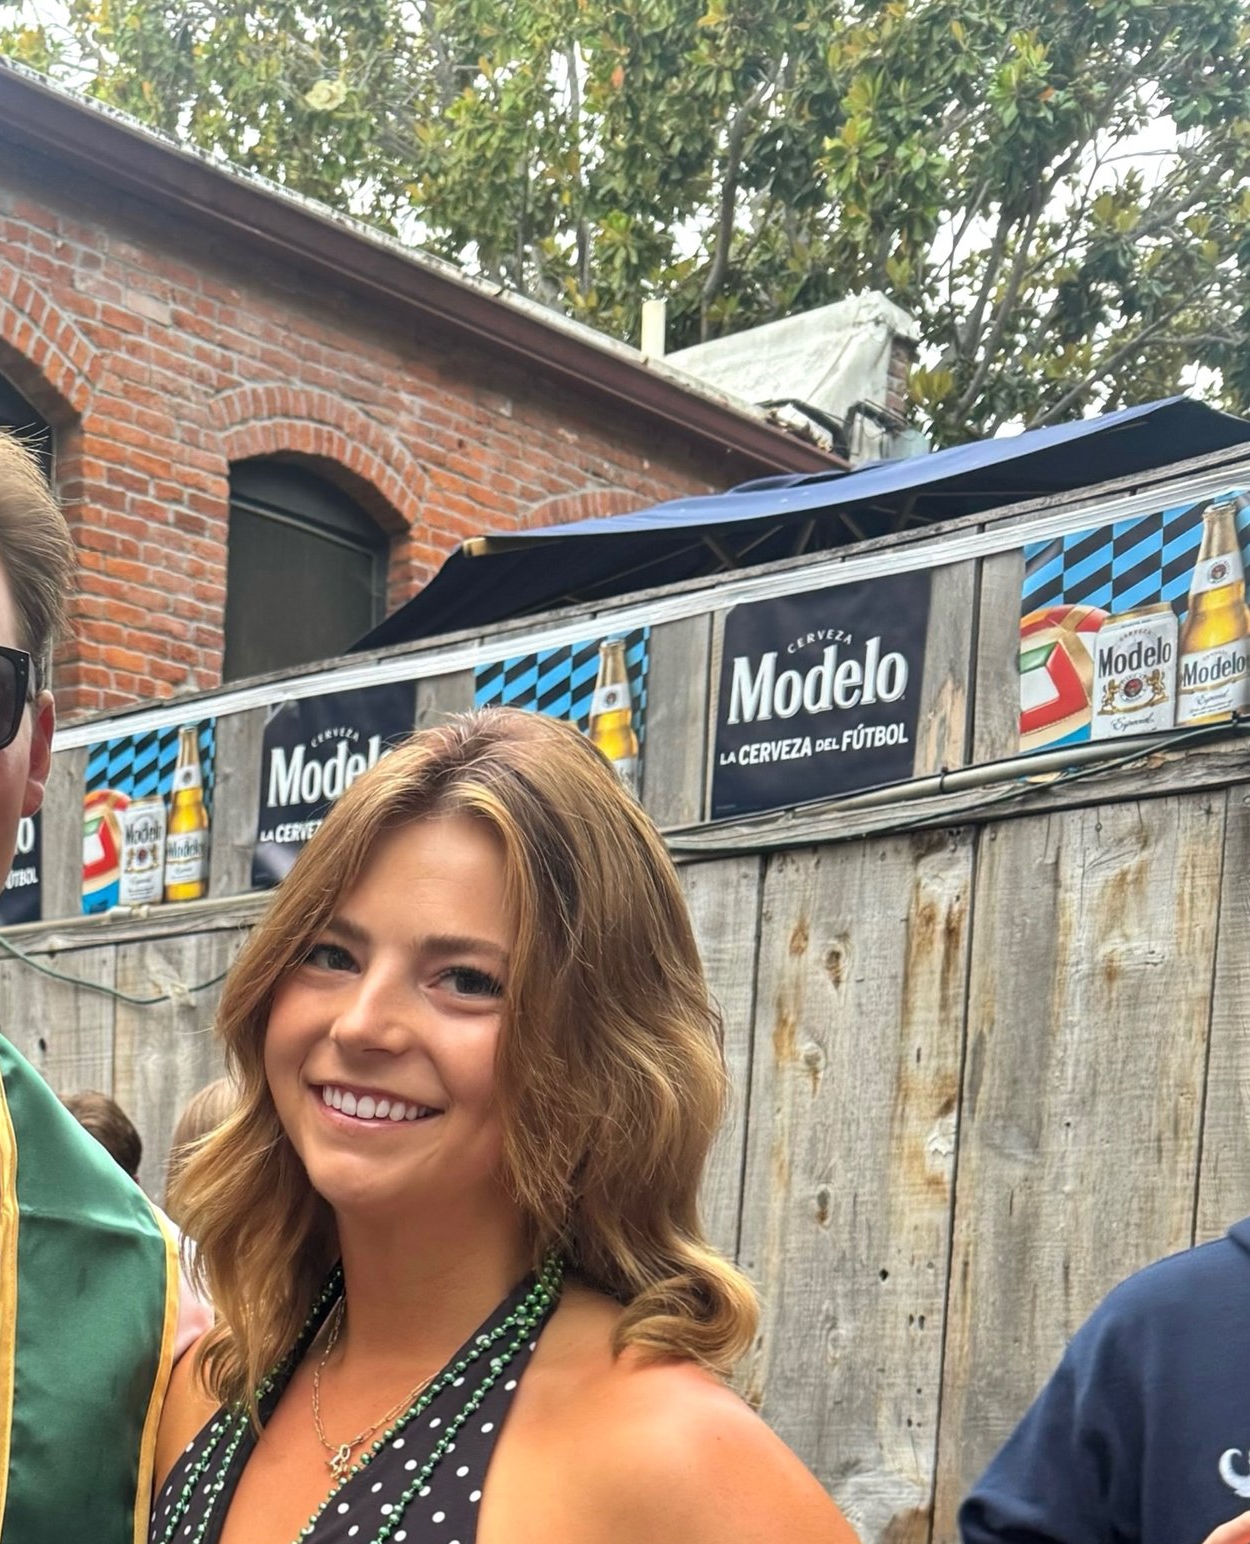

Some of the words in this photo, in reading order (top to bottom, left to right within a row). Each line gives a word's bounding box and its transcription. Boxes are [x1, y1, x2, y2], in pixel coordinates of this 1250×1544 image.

[787, 628, 853, 654] CERVEZA
[1098, 636, 1172, 679] Modelo
[727, 636, 909, 725] Modelo
[1183, 651, 1246, 688] Modelo
[311, 727, 360, 748] CERVEZA
[719, 751, 737, 765] LA
[738, 737, 812, 765] CERVEZA
[815, 737, 840, 752] DEL
[841, 723, 909, 751] FÚTBOL
[267, 735, 393, 808] Model
[260, 829, 274, 842] LA
